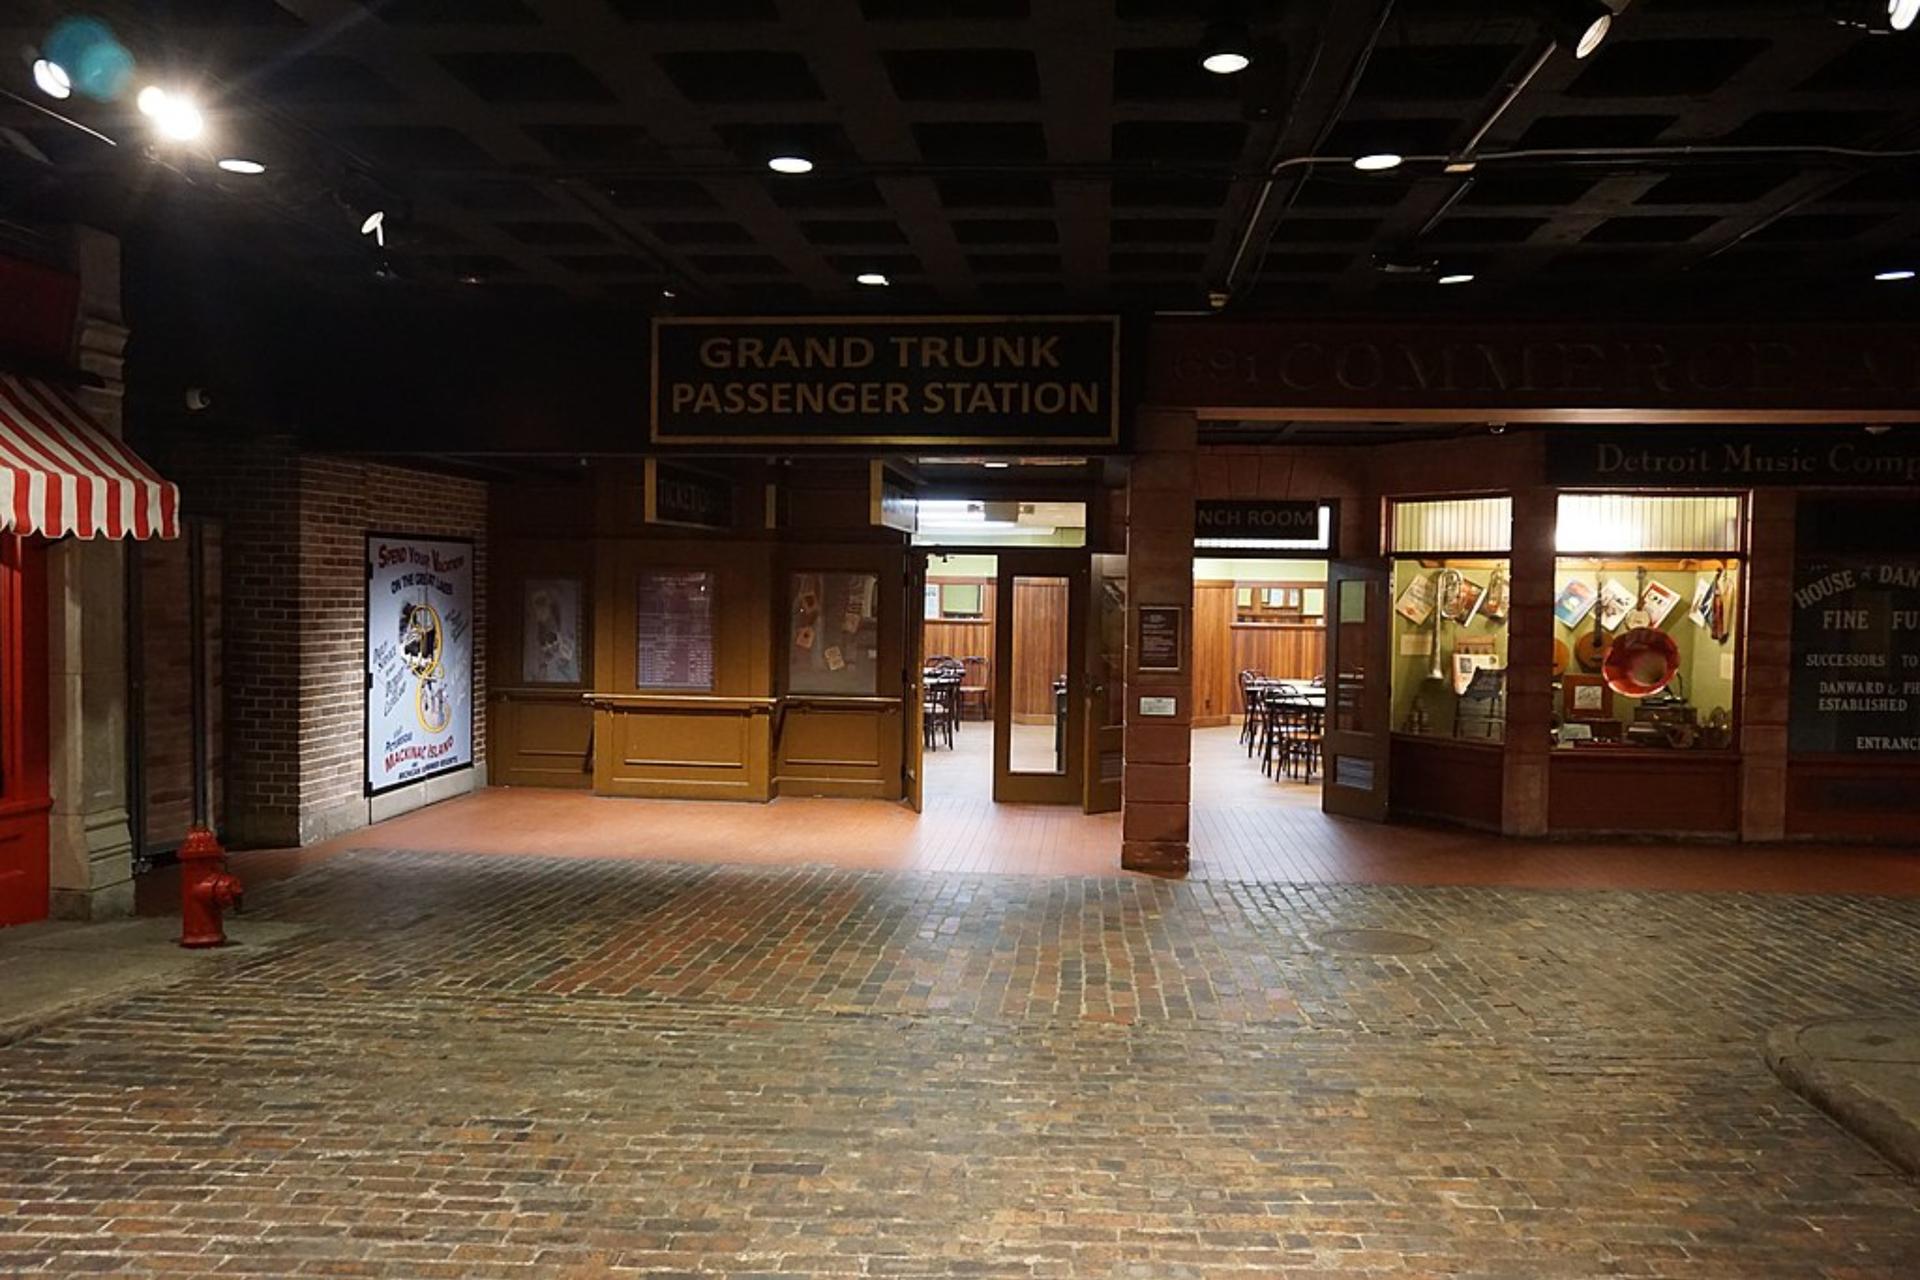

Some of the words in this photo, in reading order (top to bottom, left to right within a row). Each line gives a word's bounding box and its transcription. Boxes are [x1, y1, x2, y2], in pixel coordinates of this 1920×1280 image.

[699, 336, 875, 369] GRAND
[889, 335, 1062, 368] TRUNK
[1279, 340, 1797, 392] COMMERCE
[671, 381, 910, 415] PASSENGER
[922, 380, 1100, 415] STATION
[1596, 443, 1712, 474] Detroit
[1721, 443, 1817, 474] Music
[1247, 508, 1315, 527] ROOM
[1795, 568, 1857, 609] HOUSE
[1823, 609, 1871, 630] FINE
[1805, 652, 1887, 668] SUCCESSORS
[1900, 653, 1920, 670] TO
[1818, 681, 1885, 695] DANWARD
[1818, 697, 1909, 712] ESTABLISHED
[384, 745, 427, 773] MACKINAC
[427, 734, 455, 759] ISLAND
